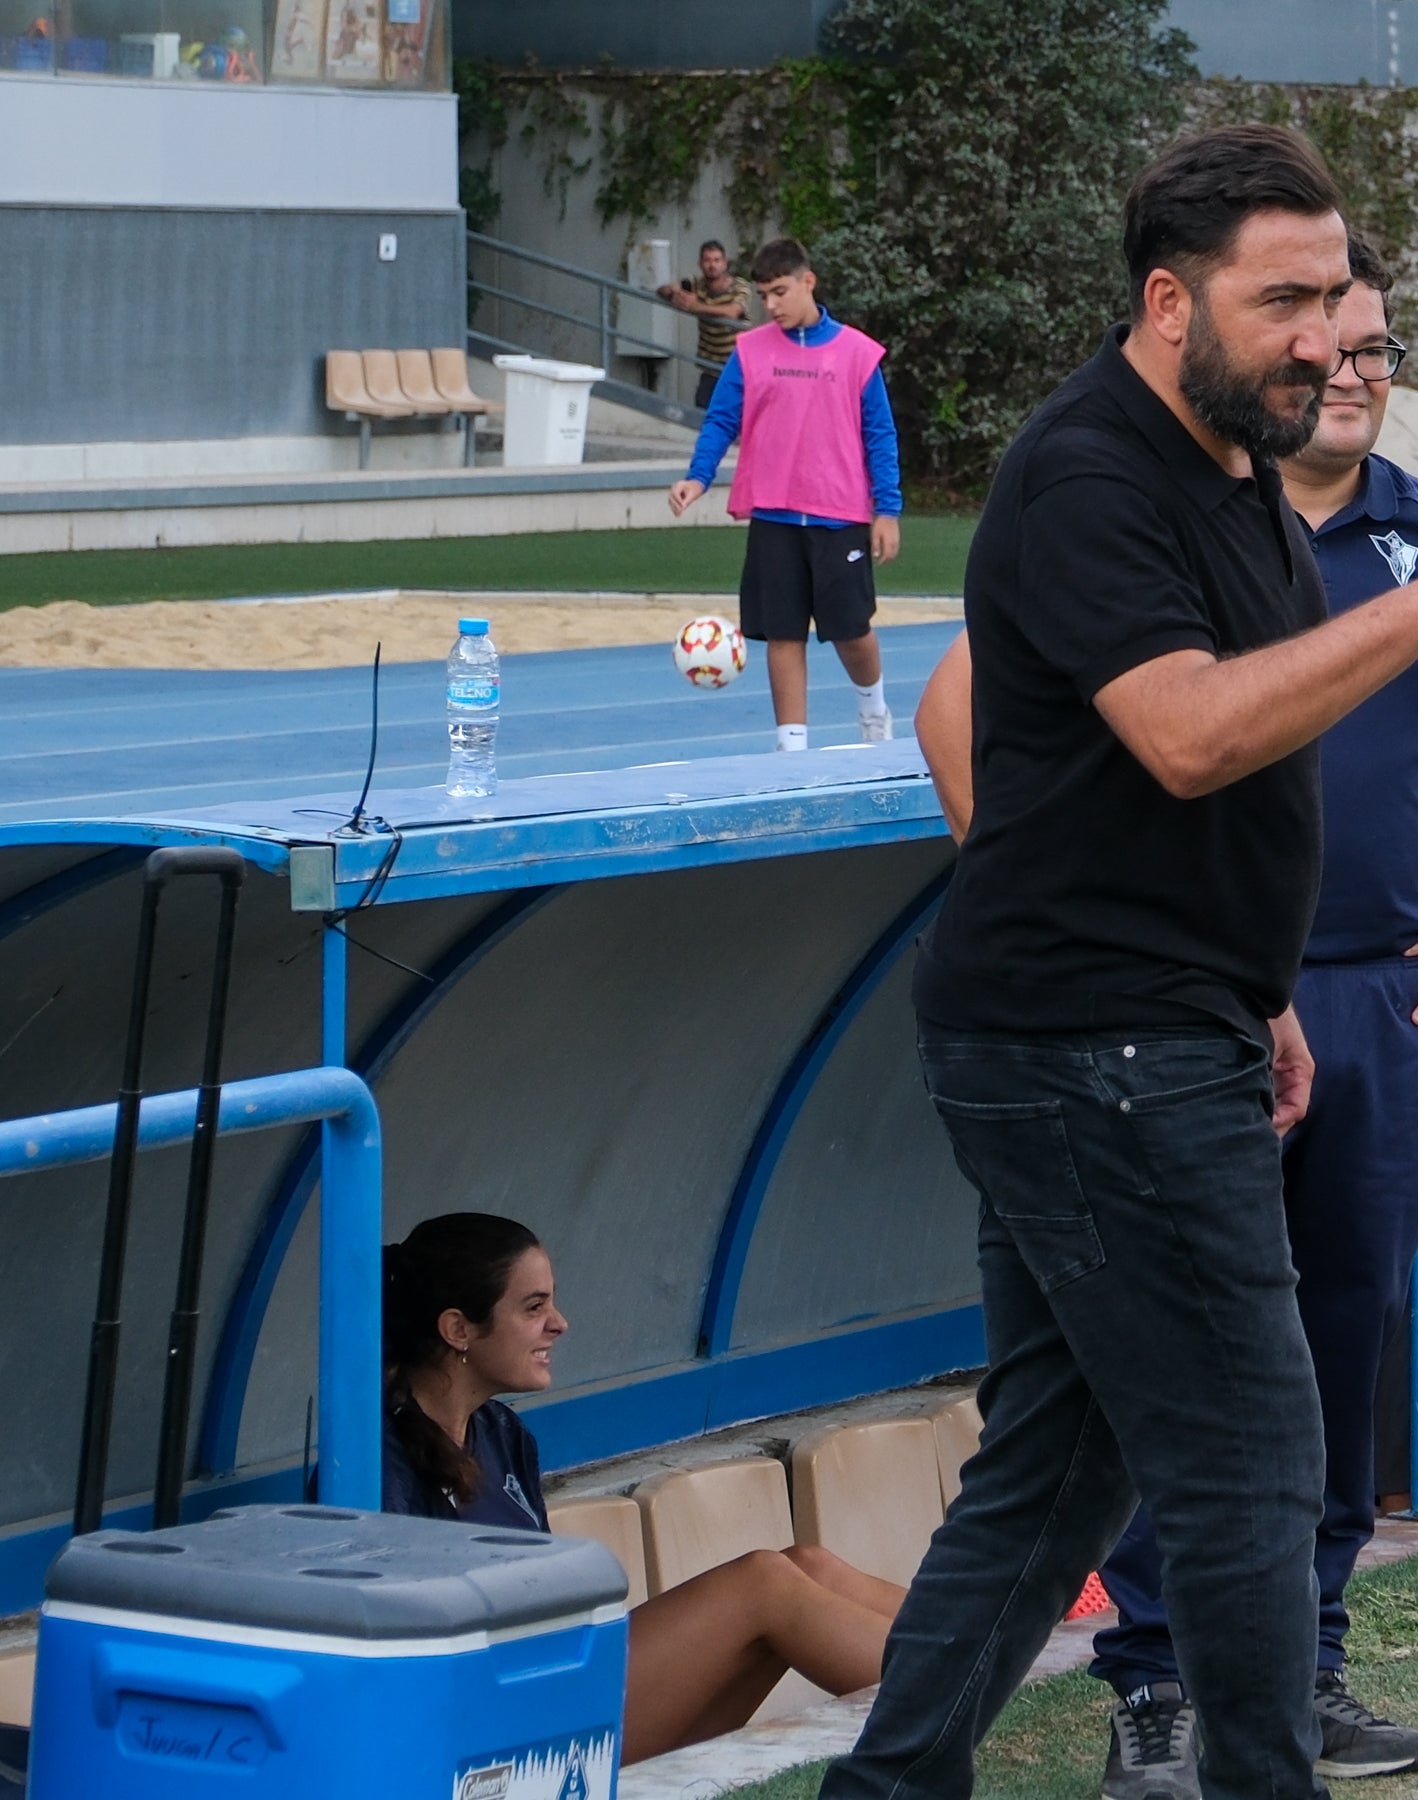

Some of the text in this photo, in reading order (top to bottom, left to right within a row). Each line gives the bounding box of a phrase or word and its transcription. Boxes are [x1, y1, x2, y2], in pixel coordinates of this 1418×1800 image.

[449, 686, 492, 698] TELENO
[462, 1774, 502, 1800] Coleman
[569, 1758, 580, 1792] 3
